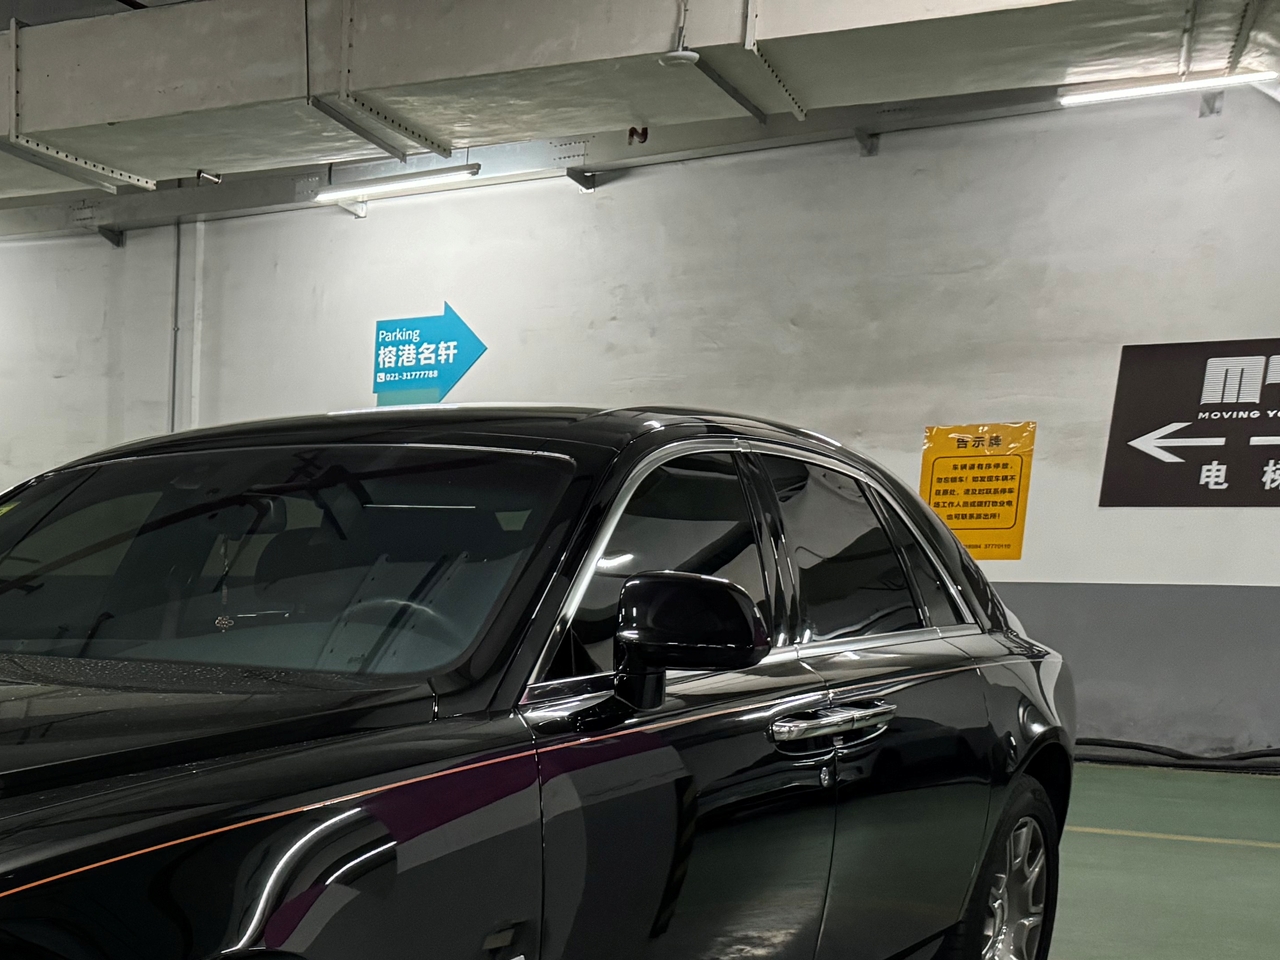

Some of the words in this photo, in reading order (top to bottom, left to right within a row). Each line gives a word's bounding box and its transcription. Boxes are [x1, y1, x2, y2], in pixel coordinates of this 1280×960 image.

[378, 328, 420, 342] Parking
[378, 341, 458, 368] 榕港名轩
[386, 370, 438, 381] 021-31777788
[1197, 410, 1261, 419] MOVING
